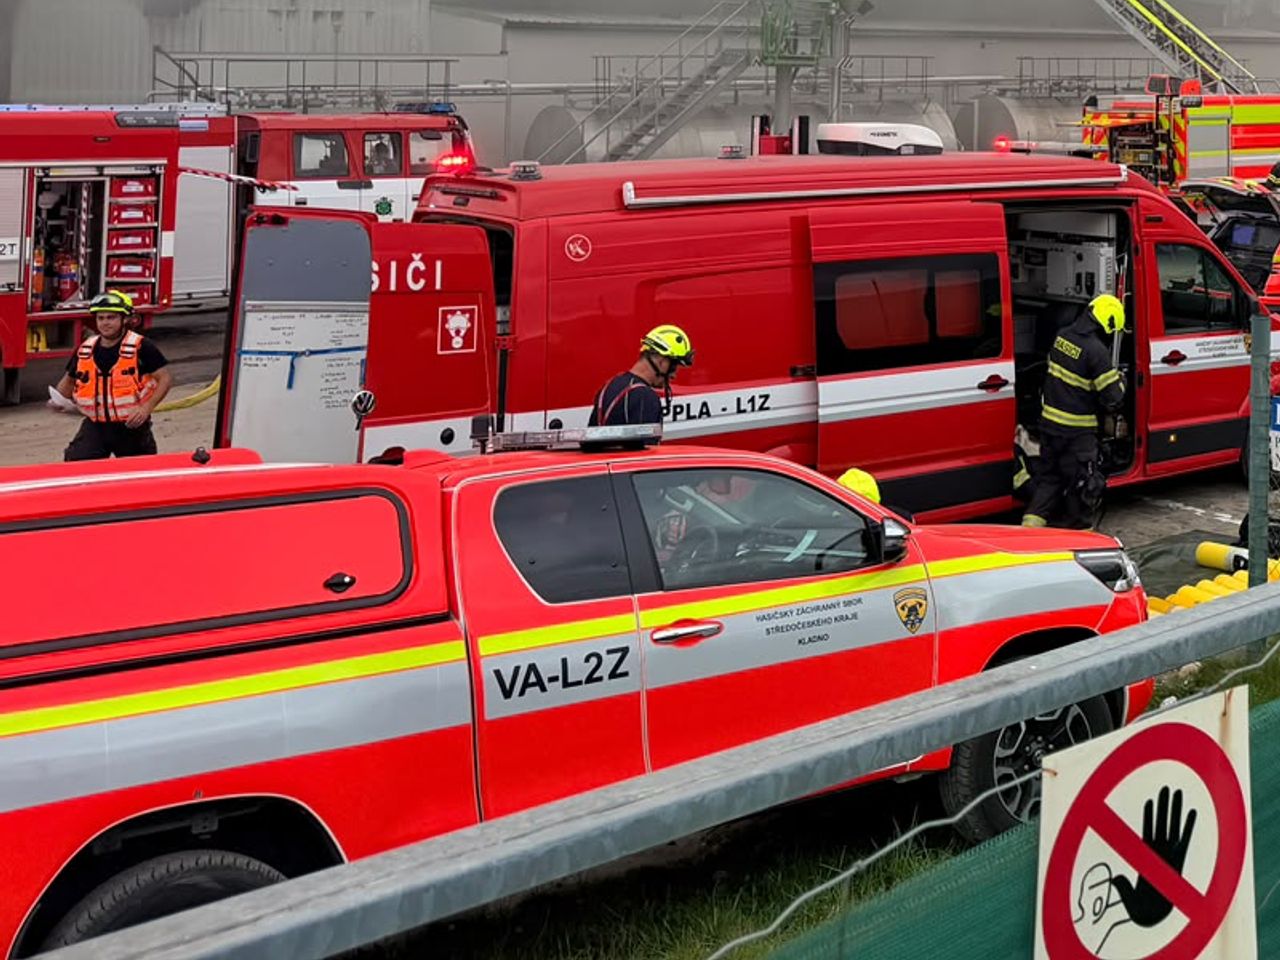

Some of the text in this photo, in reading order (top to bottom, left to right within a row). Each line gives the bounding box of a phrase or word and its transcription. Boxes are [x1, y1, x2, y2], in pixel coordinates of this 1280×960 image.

[736, 394, 771, 414] L1Z
[756, 597, 863, 622] HASIČSKÝ ZÁCHRANNÝ SBOR
[765, 611, 859, 636] STŘEDOČESKÉHO KRAJE
[797, 633, 830, 646] KLADNO
[493, 645, 630, 700] VA-L2Z
